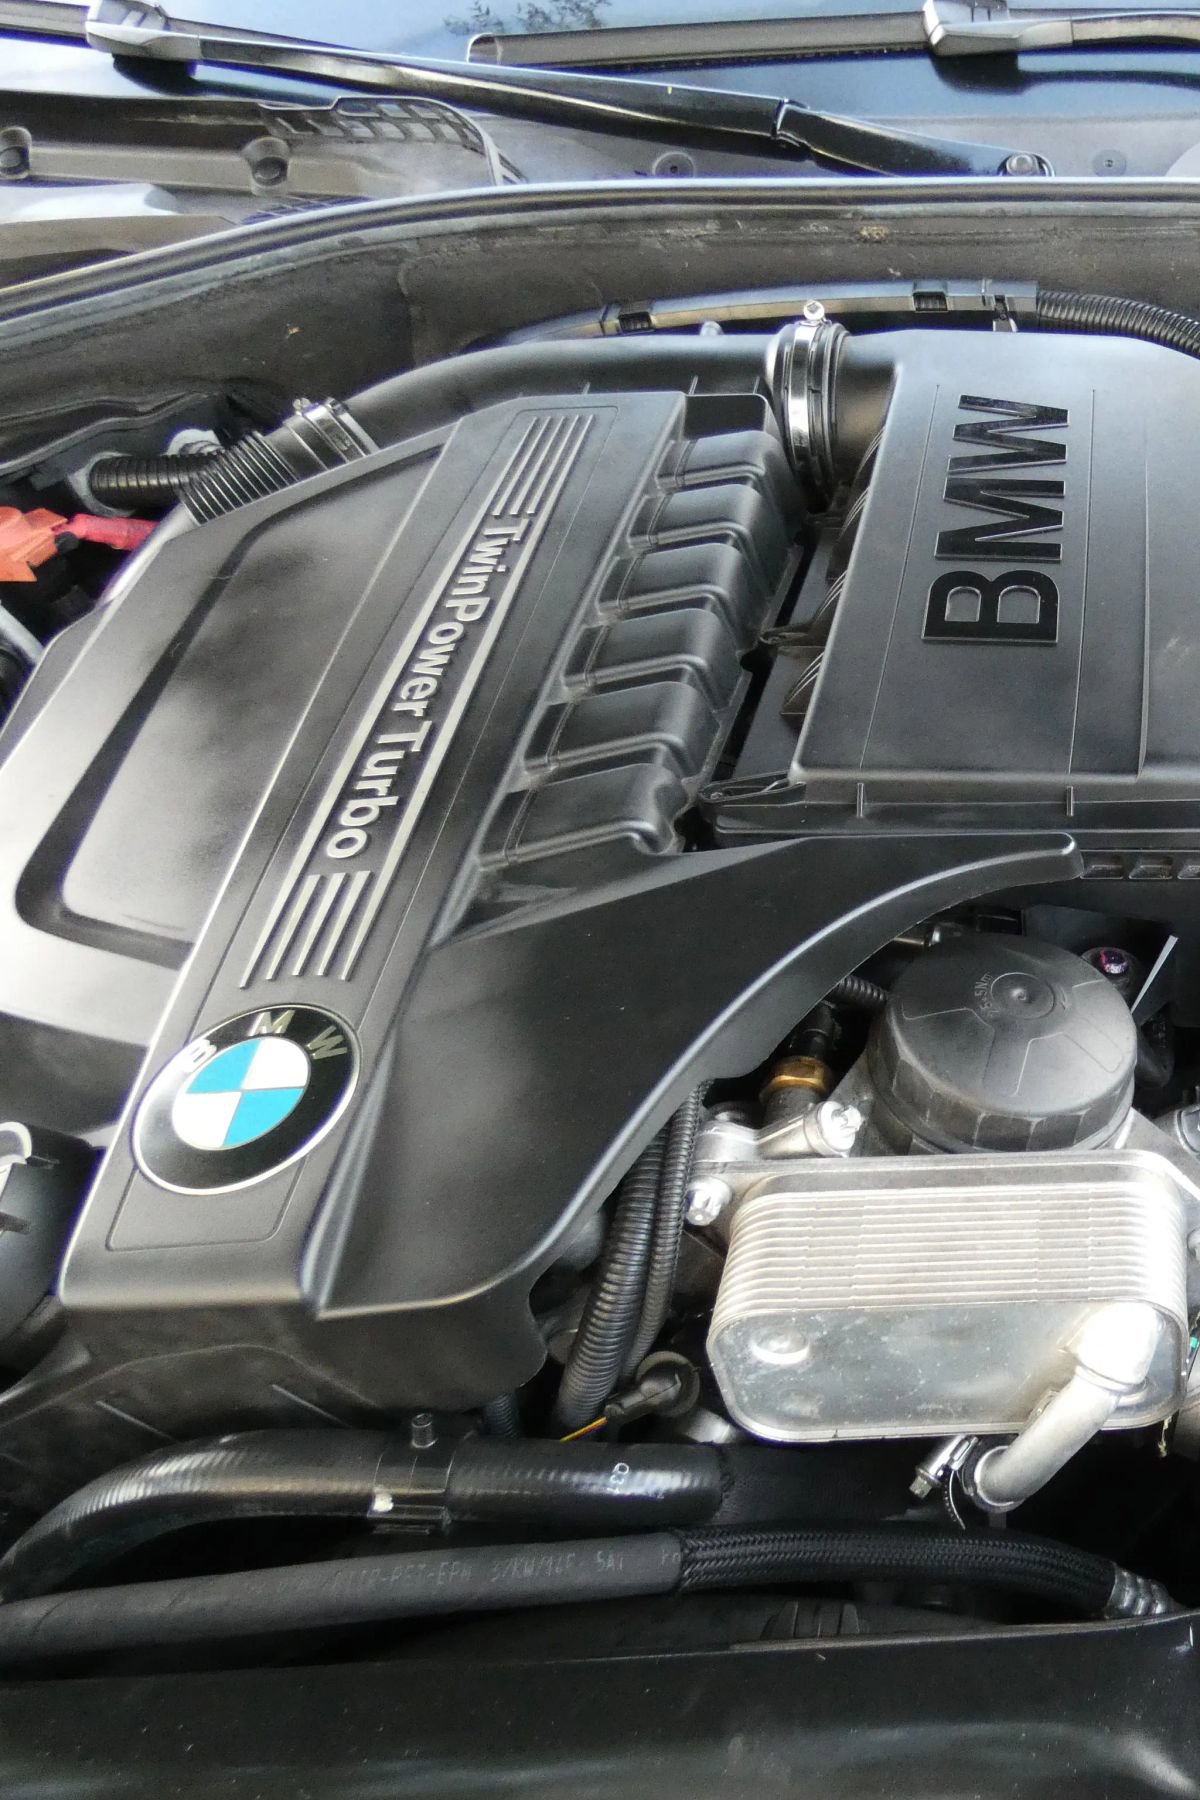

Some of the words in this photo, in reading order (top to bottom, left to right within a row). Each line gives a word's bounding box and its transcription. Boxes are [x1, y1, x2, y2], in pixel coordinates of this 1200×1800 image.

[921, 394, 1069, 644] BMW
[392, 518, 531, 717] TwinPower
[326, 720, 433, 859] Turbo
[182, 1008, 348, 1073] BMW
